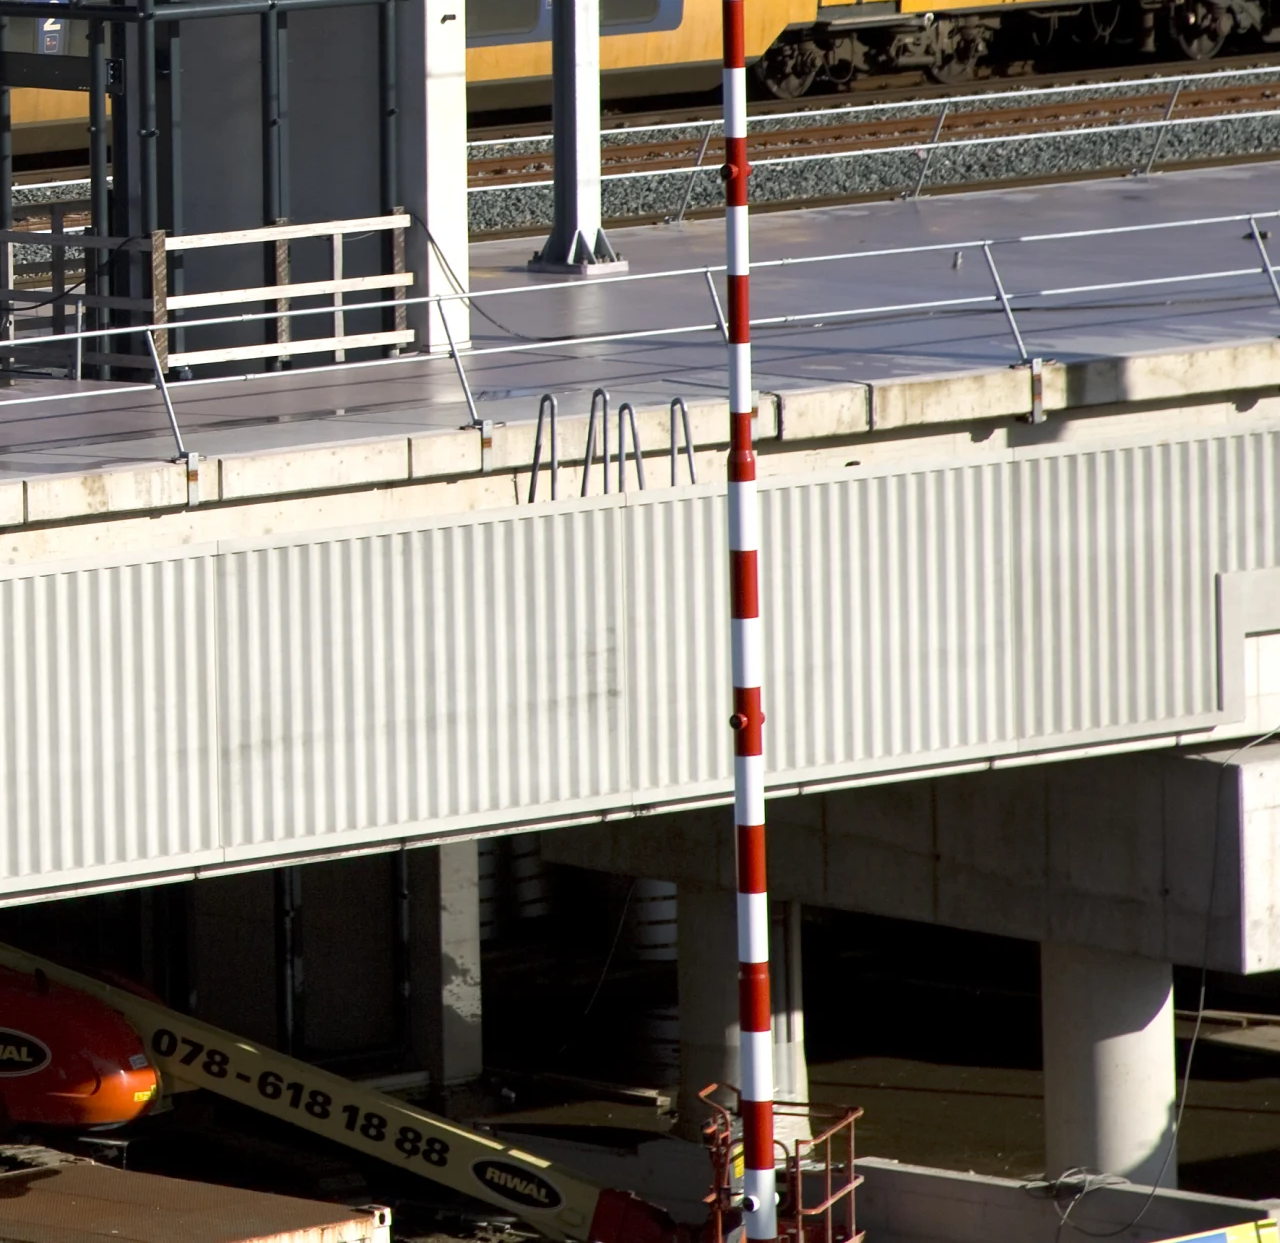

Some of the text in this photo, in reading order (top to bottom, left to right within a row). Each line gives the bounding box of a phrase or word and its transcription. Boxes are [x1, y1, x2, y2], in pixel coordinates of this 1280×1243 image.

[342, 1104, 389, 1143] 18
[395, 1126, 450, 1167] 88
[484, 1166, 551, 1204] RIWAL
